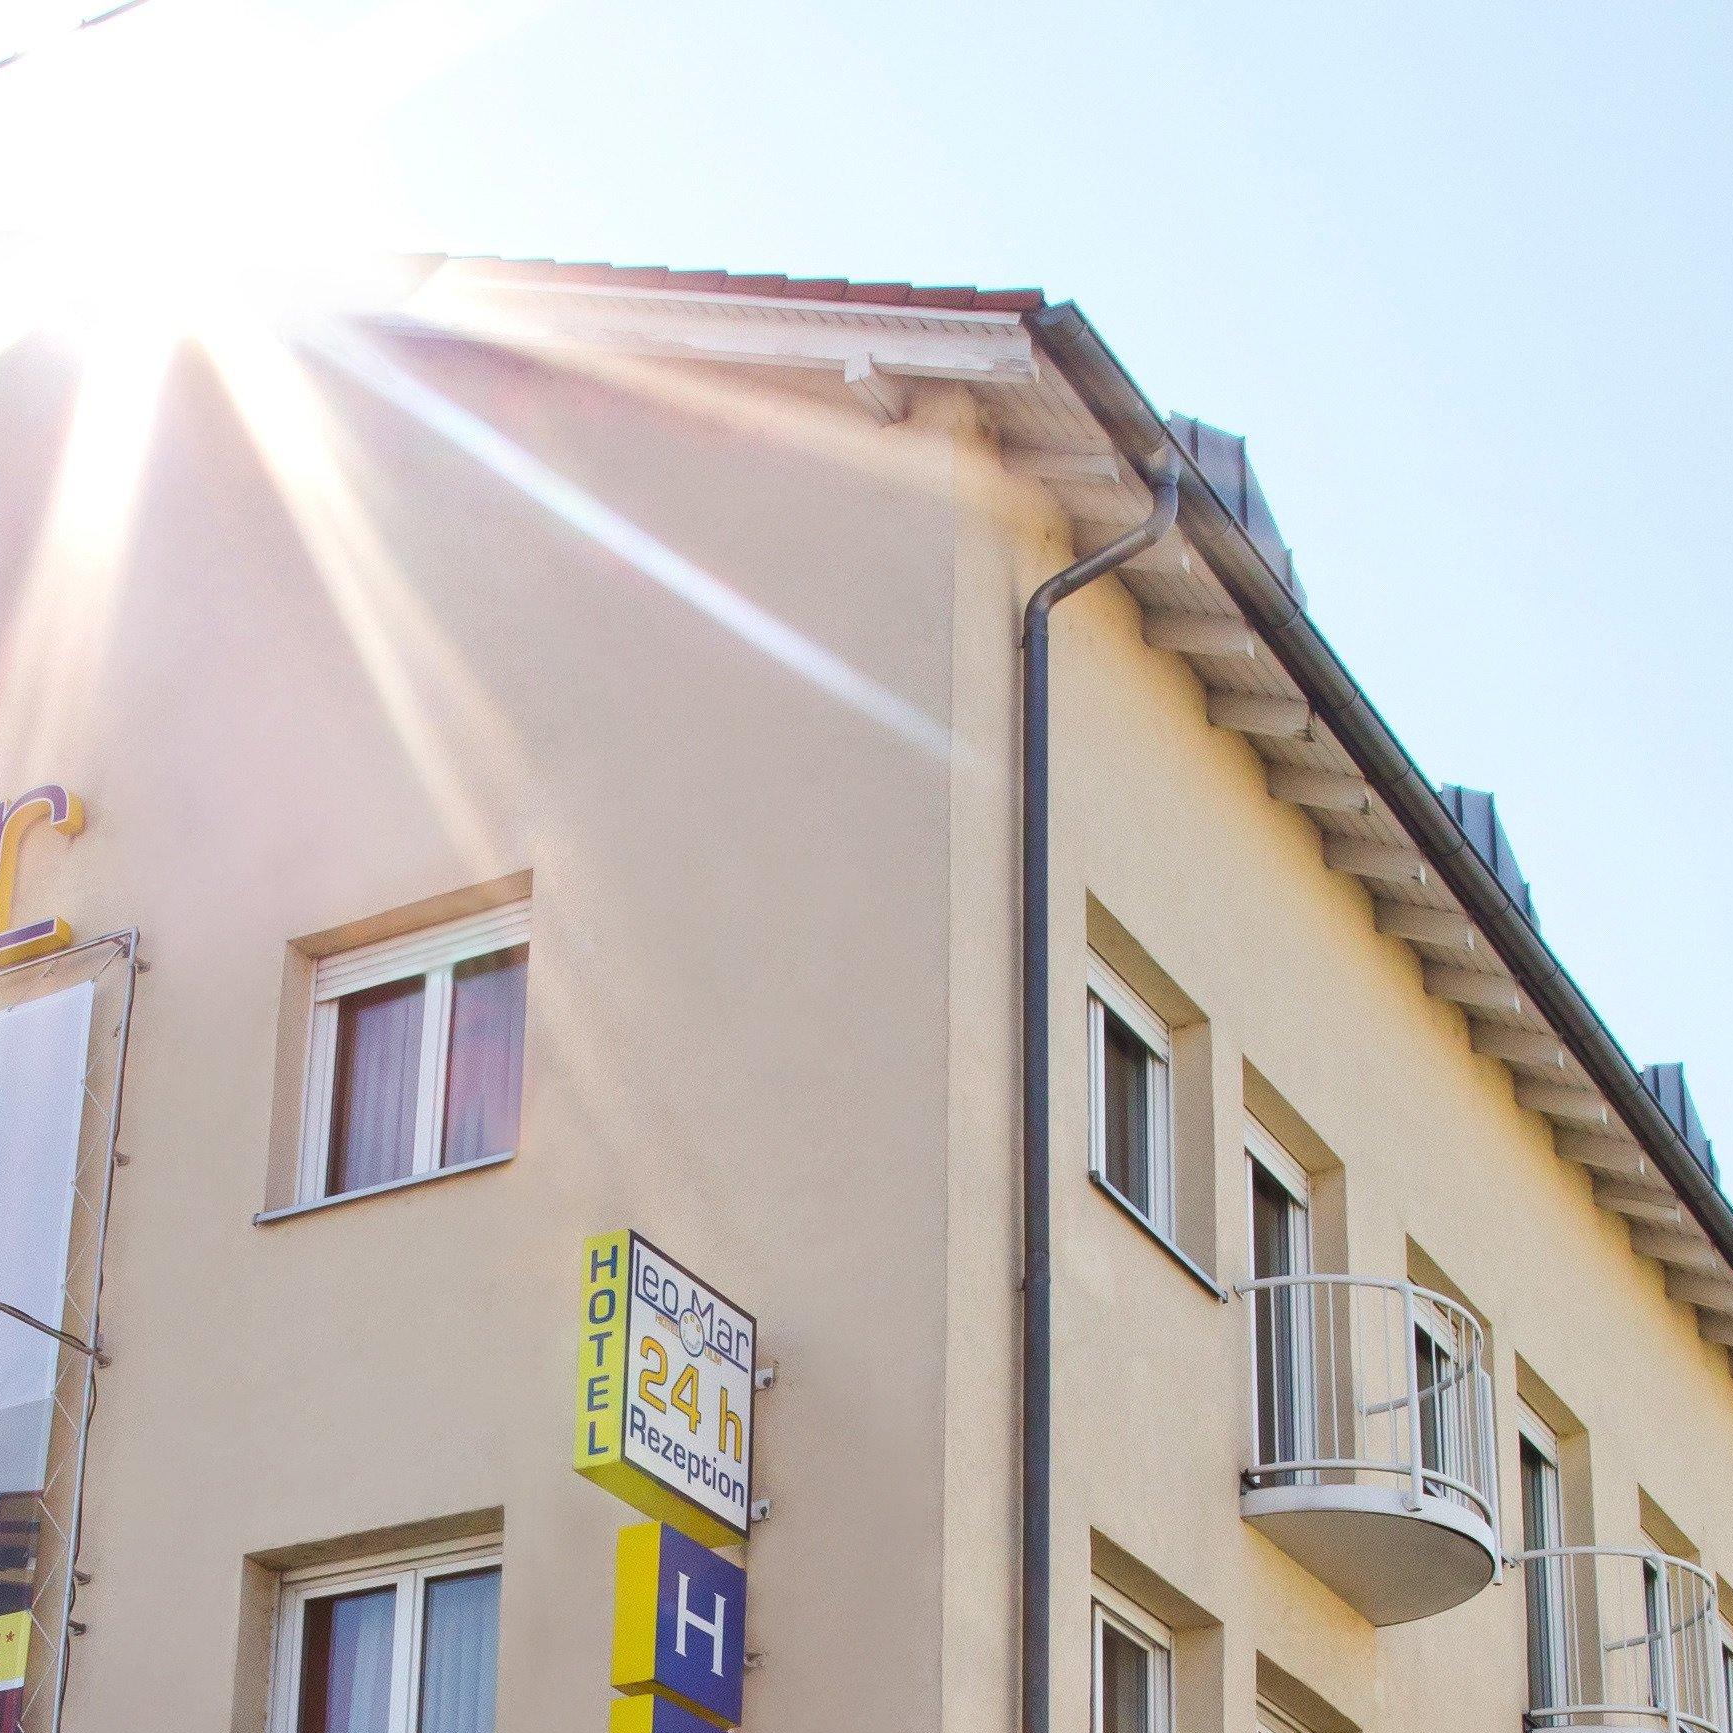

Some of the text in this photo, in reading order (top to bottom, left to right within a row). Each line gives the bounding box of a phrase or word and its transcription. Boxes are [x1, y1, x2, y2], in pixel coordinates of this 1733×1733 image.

[588, 1244, 618, 1456] HOTEL
[638, 1335, 743, 1464] 24 h
[630, 1403, 744, 1507] Rezeption
